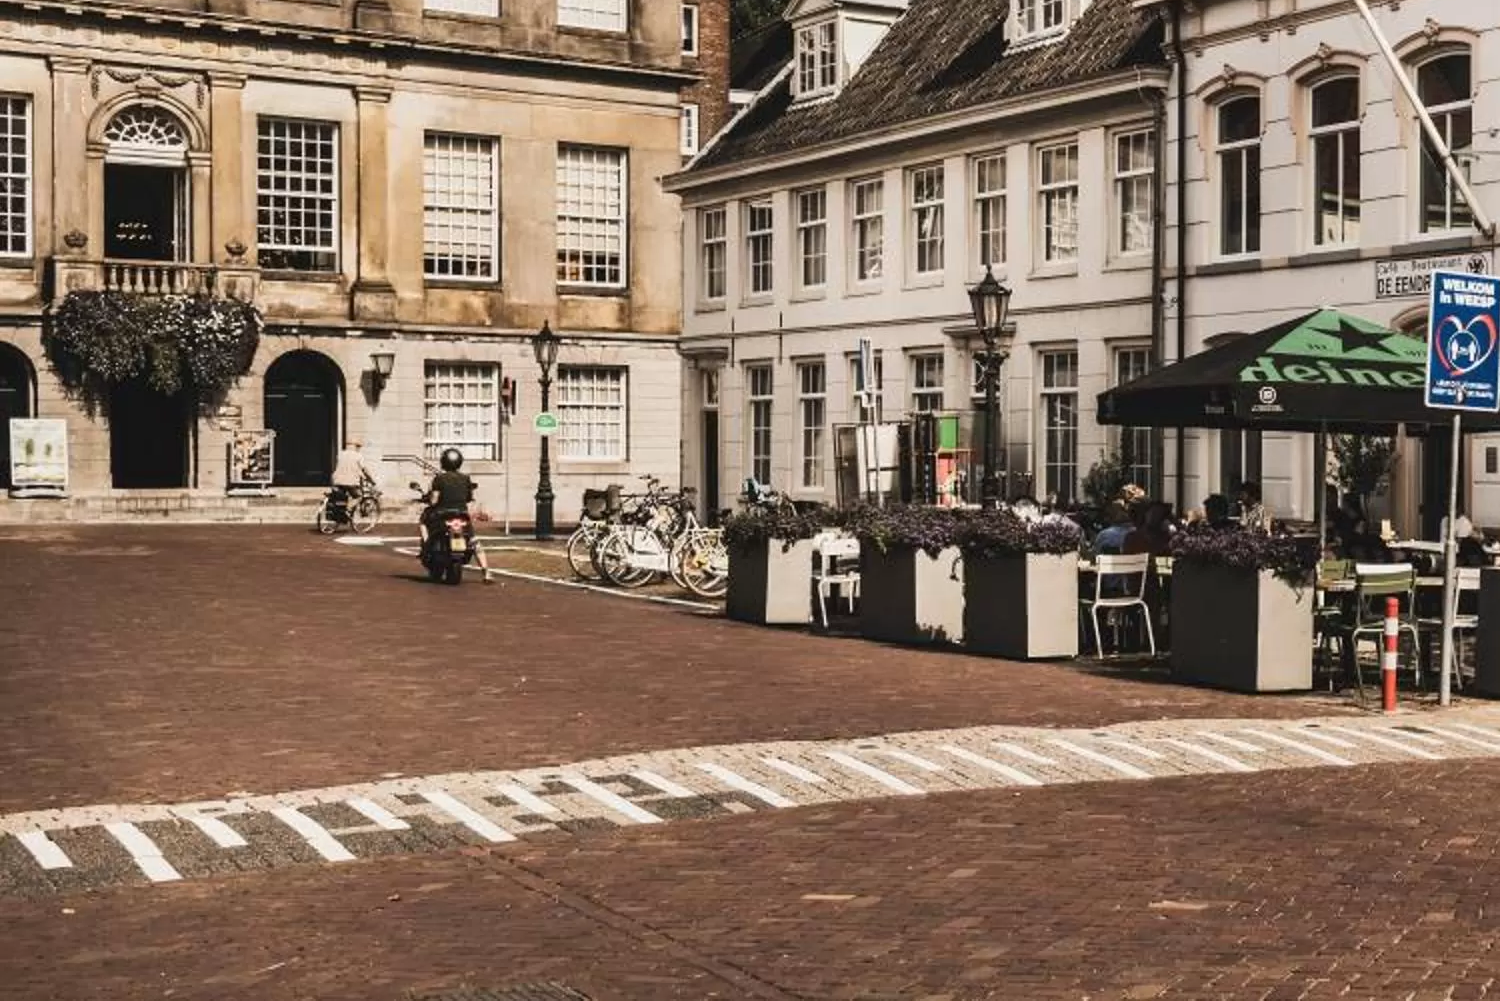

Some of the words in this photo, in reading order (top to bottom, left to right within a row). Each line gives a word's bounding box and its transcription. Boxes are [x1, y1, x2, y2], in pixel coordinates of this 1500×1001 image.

[1377, 278, 1391, 294] DE
[1395, 274, 1430, 293] EENDR
[1443, 279, 1495, 296] WELKOM
[1440, 291, 1452, 304] in
[1455, 294, 1496, 308] WEESP
